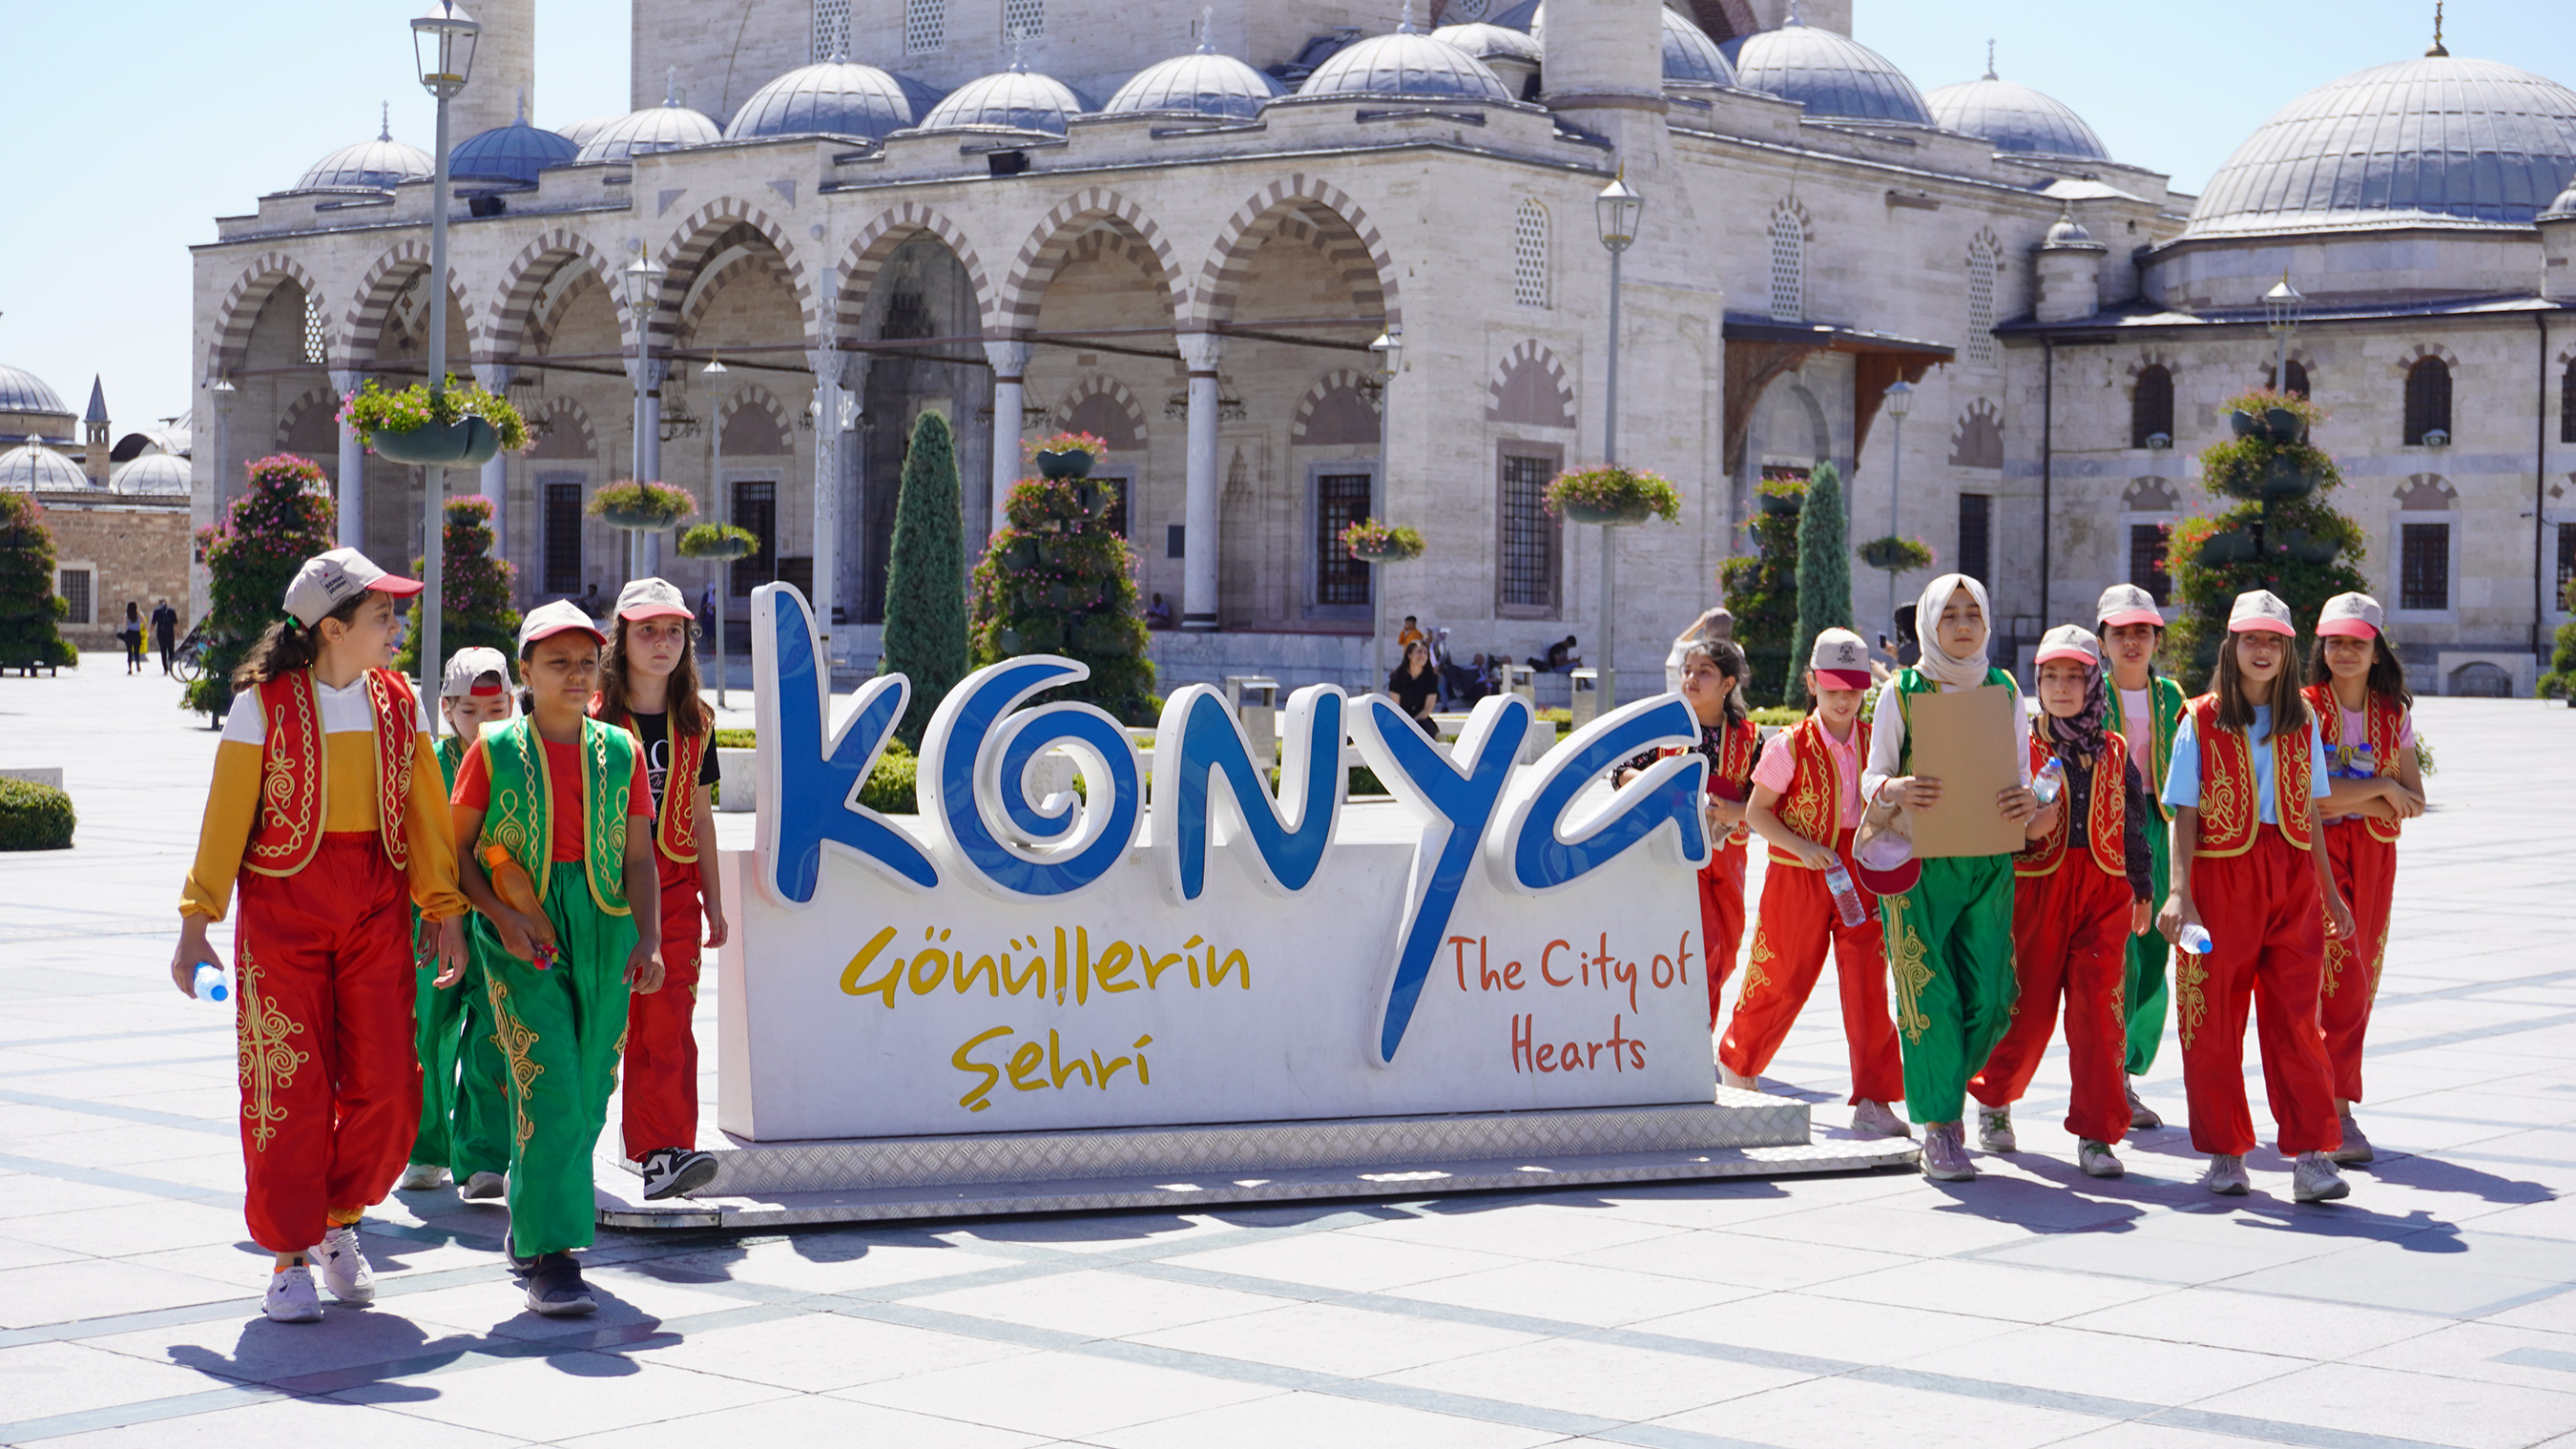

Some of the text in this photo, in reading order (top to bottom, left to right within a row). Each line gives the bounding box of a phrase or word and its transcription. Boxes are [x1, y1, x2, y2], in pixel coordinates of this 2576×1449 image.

[754, 583, 1711, 1066] KONYA
[839, 925, 1250, 1009] Gönüllerin
[1446, 930, 1694, 1015] The City of
[951, 1025, 1153, 1112] Şehri
[1511, 1013, 1647, 1074] Hearts
